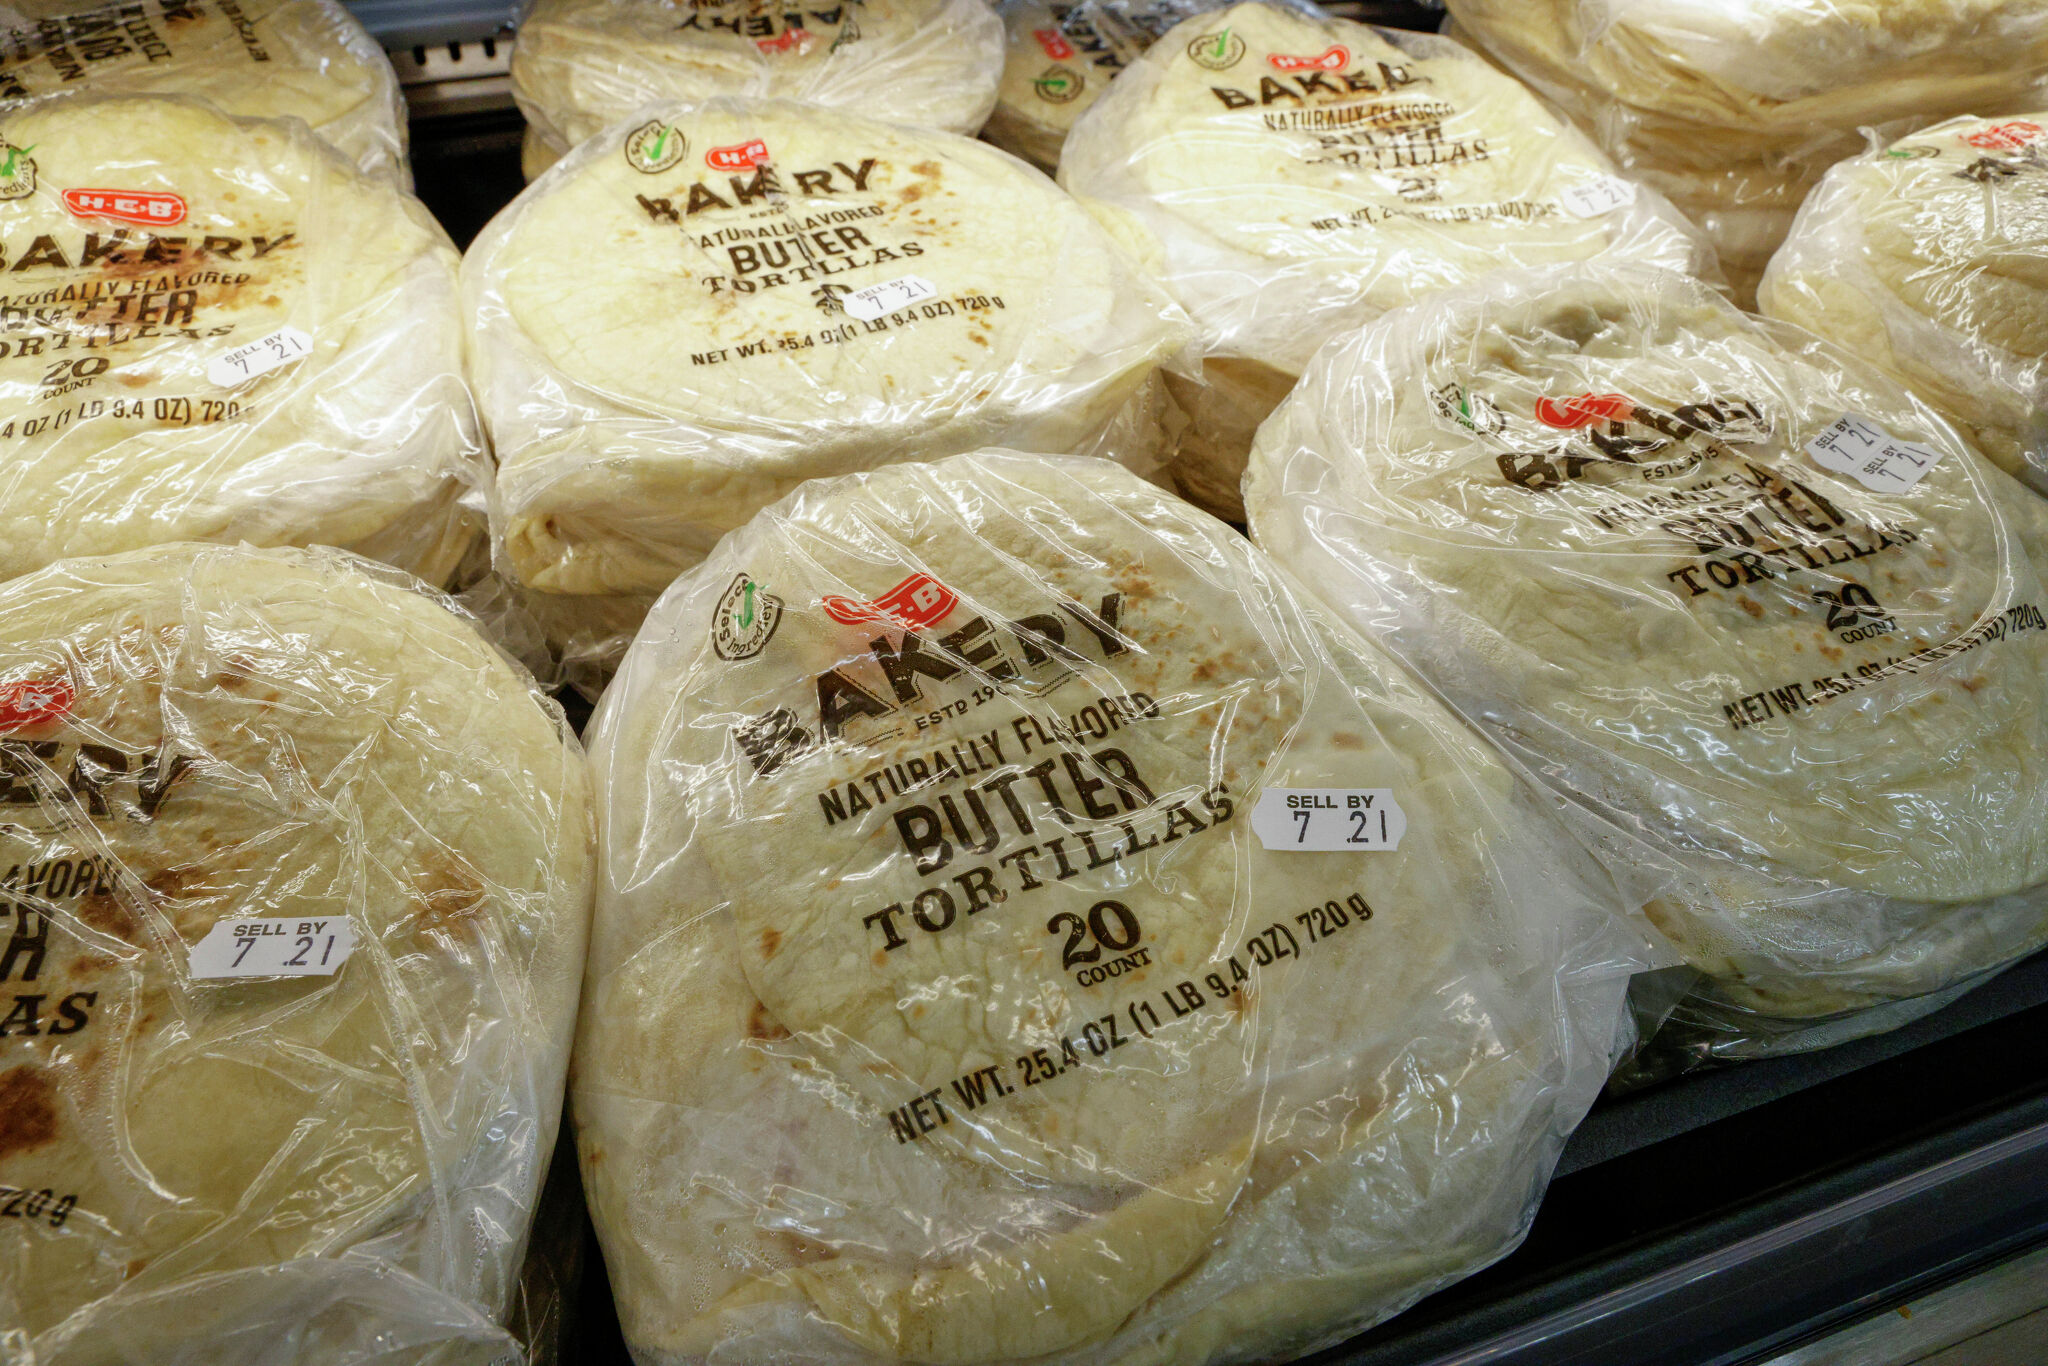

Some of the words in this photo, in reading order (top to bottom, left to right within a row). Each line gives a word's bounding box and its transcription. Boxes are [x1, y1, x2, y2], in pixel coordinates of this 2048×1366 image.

[635, 159, 876, 221] BAKRY
[701, 222, 797, 248] ATURALL
[794, 205, 885, 232] LAVORED
[0, 229, 297, 273] AKERY
[702, 241, 924, 294] TORTLLAS
[868, 296, 884, 311] 7
[224, 345, 259, 364] SELL
[263, 333, 284, 347] BY
[692, 348, 729, 366] NET
[736, 340, 773, 360] WT.
[891, 311, 919, 327] 9.4
[923, 299, 955, 320] OZ)
[955, 294, 990, 312] 720
[40, 356, 111, 388] 20
[233, 358, 250, 375] 7
[43, 377, 97, 400] COUNT
[22, 416, 51, 437] OZ
[153, 396, 192, 426] OZ)
[1815, 431, 1840, 450] SELL
[1834, 418, 1851, 433] BY
[1828, 444, 1855, 461] 7
[1847, 422, 1881, 448] 21
[1863, 457, 1888, 475] SELL
[1881, 445, 1899, 458] BY
[1877, 468, 1906, 482] 7
[1896, 446, 1932, 468] 21
[1811, 582, 1886, 632] 20
[1840, 616, 1897, 645] COUNT
[735, 592, 1131, 777] BAKERY
[1722, 690, 1775, 731] NET
[818, 729, 1007, 826] NATURALLY
[893, 747, 1156, 877] BUTTER
[1286, 794, 1338, 809] SELL
[1347, 794, 1374, 809] BY
[1293, 810, 1311, 843] 7
[862, 781, 1236, 952] TORTILLAS
[233, 923, 287, 937] SELL
[296, 921, 328, 936] BY
[1047, 899, 1141, 972] 20
[231, 937, 257, 969] 7
[1076, 947, 1152, 987] COUNT
[888, 1087, 950, 1145] NET
[950, 1064, 1015, 1112] WT.
[1016, 1036, 1081, 1088] 25.4
[1081, 1013, 1129, 1058] OZ
[1128, 1000, 1162, 1039] (1
[1161, 980, 1207, 1019] LB
[1205, 955, 1250, 999] 9.4
[1246, 923, 1300, 967] OZ)
[1294, 900, 1350, 944] 720
